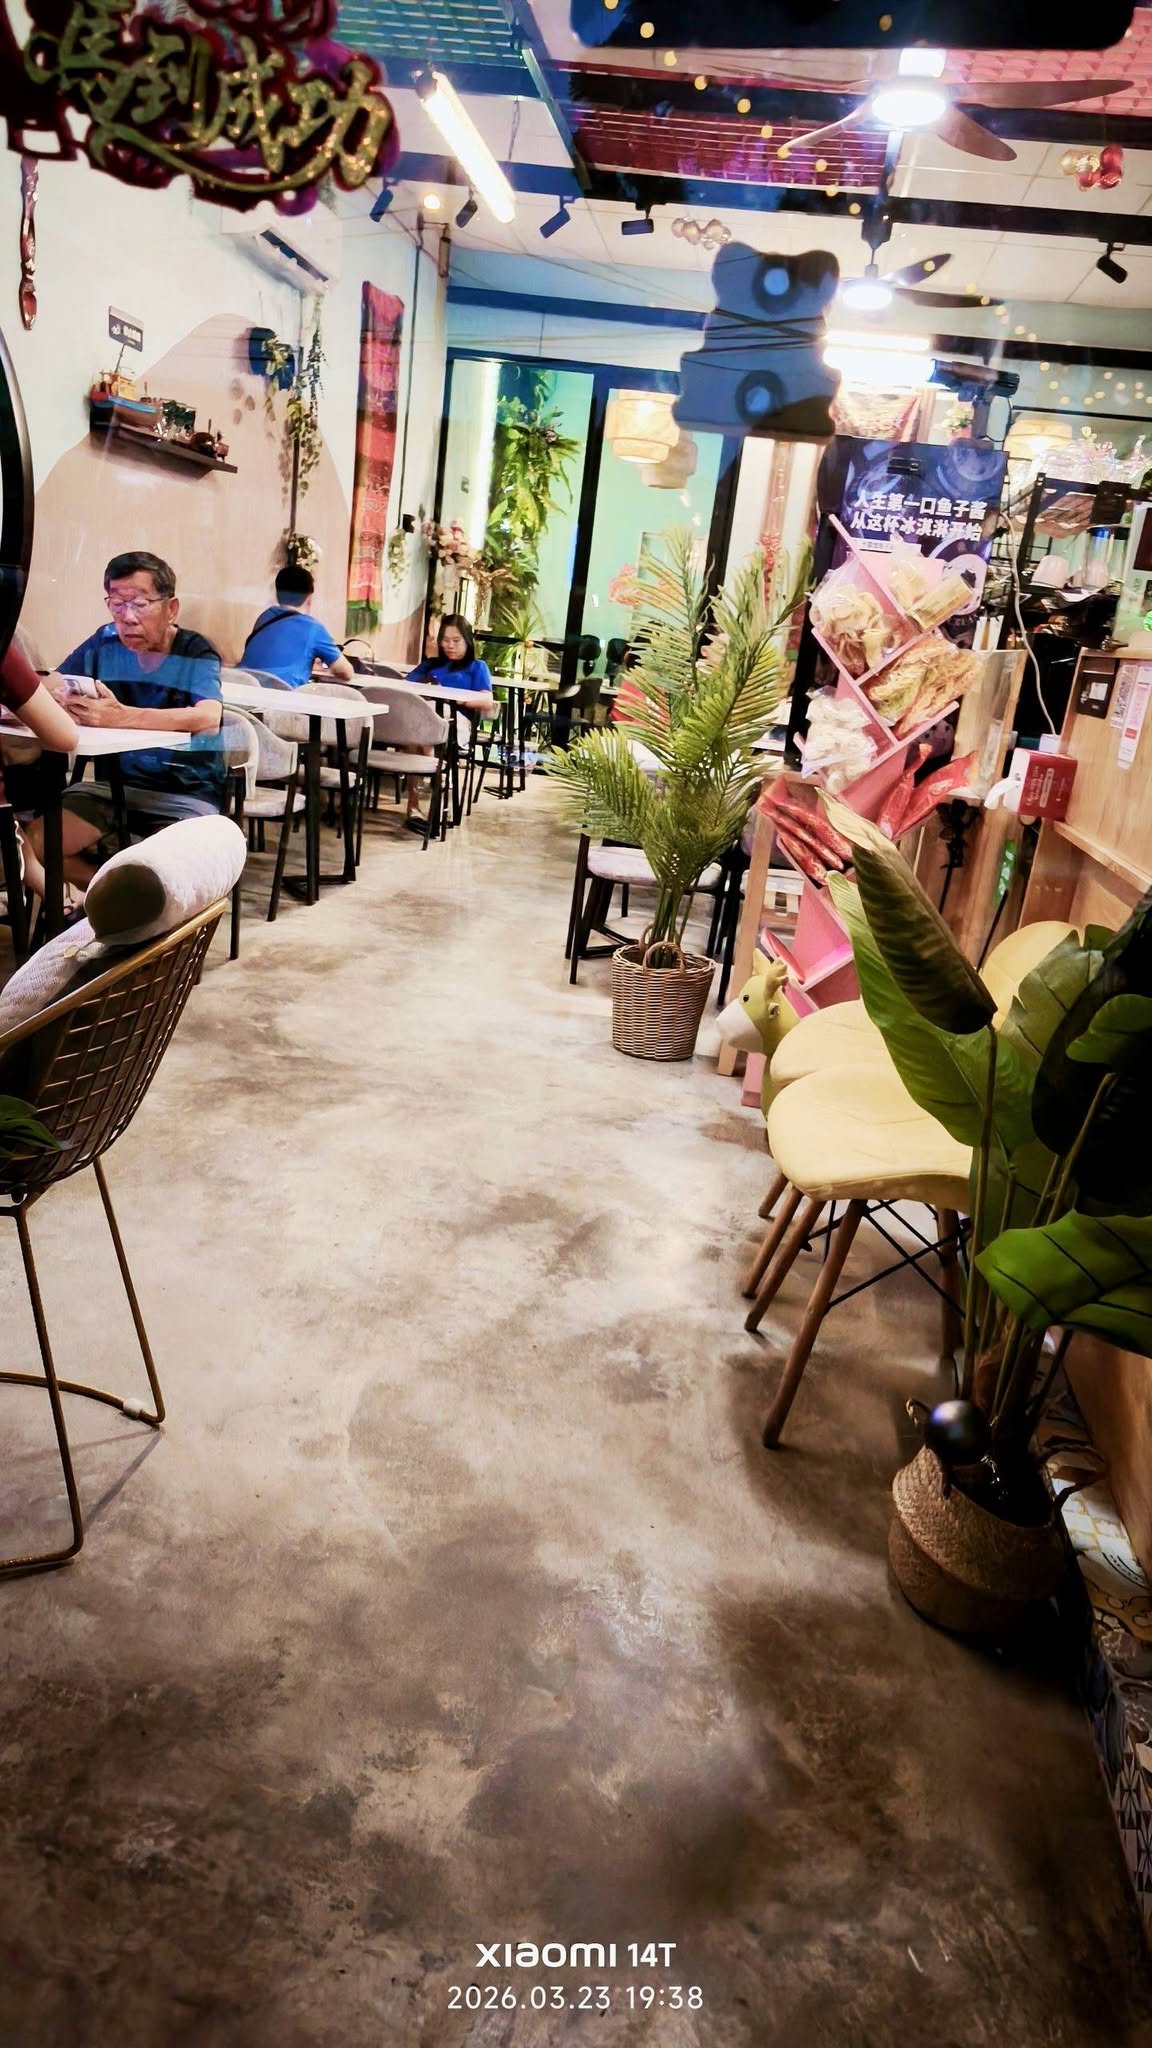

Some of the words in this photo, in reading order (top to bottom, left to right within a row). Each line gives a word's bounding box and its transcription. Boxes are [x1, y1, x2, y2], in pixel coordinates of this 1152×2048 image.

[854, 489, 988, 521] 人生第一口鱼子酱
[850, 510, 983, 542] 从这杯冰淇淋开始
